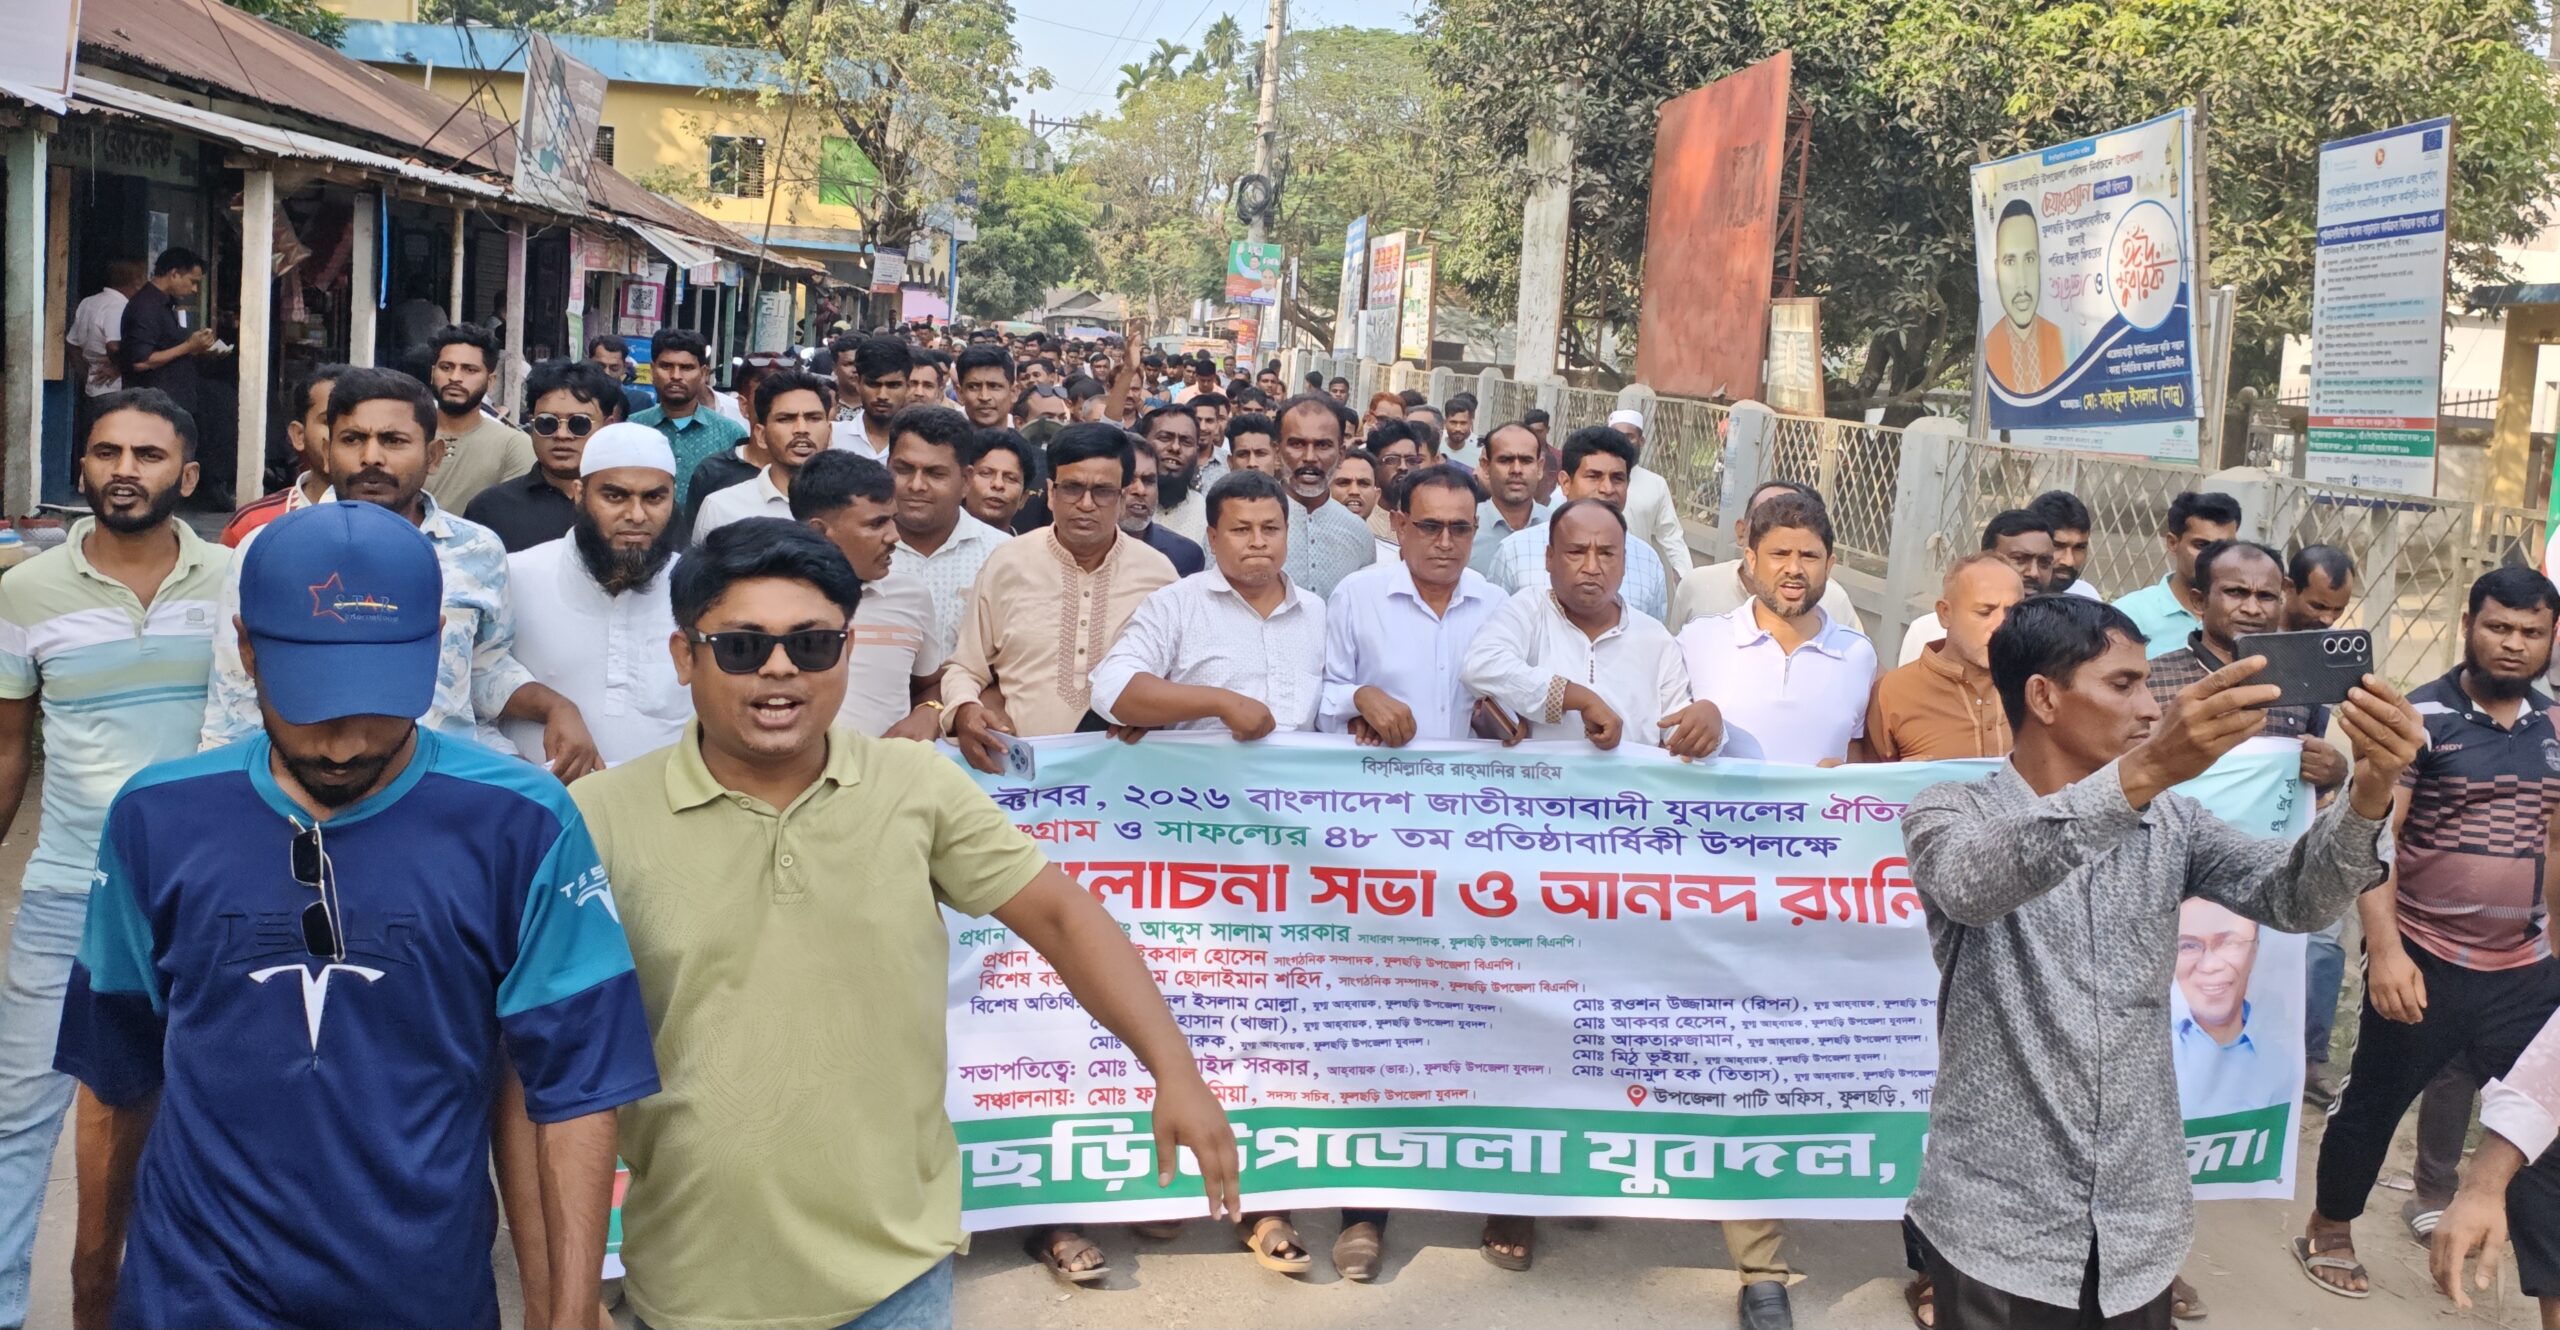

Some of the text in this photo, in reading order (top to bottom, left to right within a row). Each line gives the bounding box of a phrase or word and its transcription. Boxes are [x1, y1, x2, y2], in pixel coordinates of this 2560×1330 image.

[1520, 761, 1563, 780] রাহিম
[1123, 785, 1909, 827] ২০২৬ বাংলাদেশ জাতীয়তাবাদী যুবদলের ঐতি
[1114, 821, 1142, 840] ও
[1154, 819, 1311, 847] সাফল্যের
[1324, 826, 1379, 850] ৪৮
[1391, 827, 1455, 850] তম
[1697, 828, 1844, 858] উপলক্ষে
[559, 864, 606, 898] TES
[1310, 866, 1435, 918] সভা
[1458, 870, 1518, 918] ও
[1540, 870, 1758, 922] আনন্দ
[218, 910, 417, 947] TELA
[958, 927, 1008, 948] প্রধান
[1139, 920, 1203, 944] আব্দুস
[1209, 922, 1273, 943] সালাম
[1279, 921, 1353, 945] সরকার
[1449, 935, 1487, 951] ফুলছড়ি
[1490, 934, 1533, 949] উপজেলা
[983, 950, 1030, 969] প্রধান
[1204, 947, 1269, 966] হোসেন
[1384, 954, 1422, 969] ফুলছড়ি
[1426, 956, 1470, 971] উপজেলা
[978, 969, 1032, 991] বিশেষ
[1175, 966, 1269, 989] ছোলাইমান
[1448, 977, 1486, 994] ফুলছড়ি
[1491, 979, 1535, 994] উপজেলা
[970, 996, 1018, 1015] বিশেষ
[1192, 992, 1250, 1011] ইসলাম
[1423, 998, 1464, 1011] উপজেলা
[1573, 999, 1605, 1012] মোঃ
[1610, 997, 1660, 1012] রওশন
[1413, 1016, 1454, 1029] উপজেলা
[1573, 1016, 1605, 1030] মোঃ
[1610, 1016, 1670, 1030] আকবর
[1090, 1035, 1122, 1050] মোঃ
[1351, 1037, 1392, 1049] উপজেলা
[1573, 1033, 1605, 1047] মোঃ
[1572, 1049, 1604, 1062] মোঃ
[1088, 1059, 1127, 1078] মোঃ
[1465, 1060, 1509, 1074] উপজেলা
[1572, 1064, 1604, 1077] মোঃ
[1610, 1067, 1669, 1083] এনামুল
[1674, 1067, 1702, 1081] হক
[1088, 1087, 1127, 1106] মোঃ
[1384, 1088, 1432, 1102] উপজেলা
[1653, 1087, 1728, 1108] উপজেলা
[958, 1117, 1156, 1192] ছড়ি
